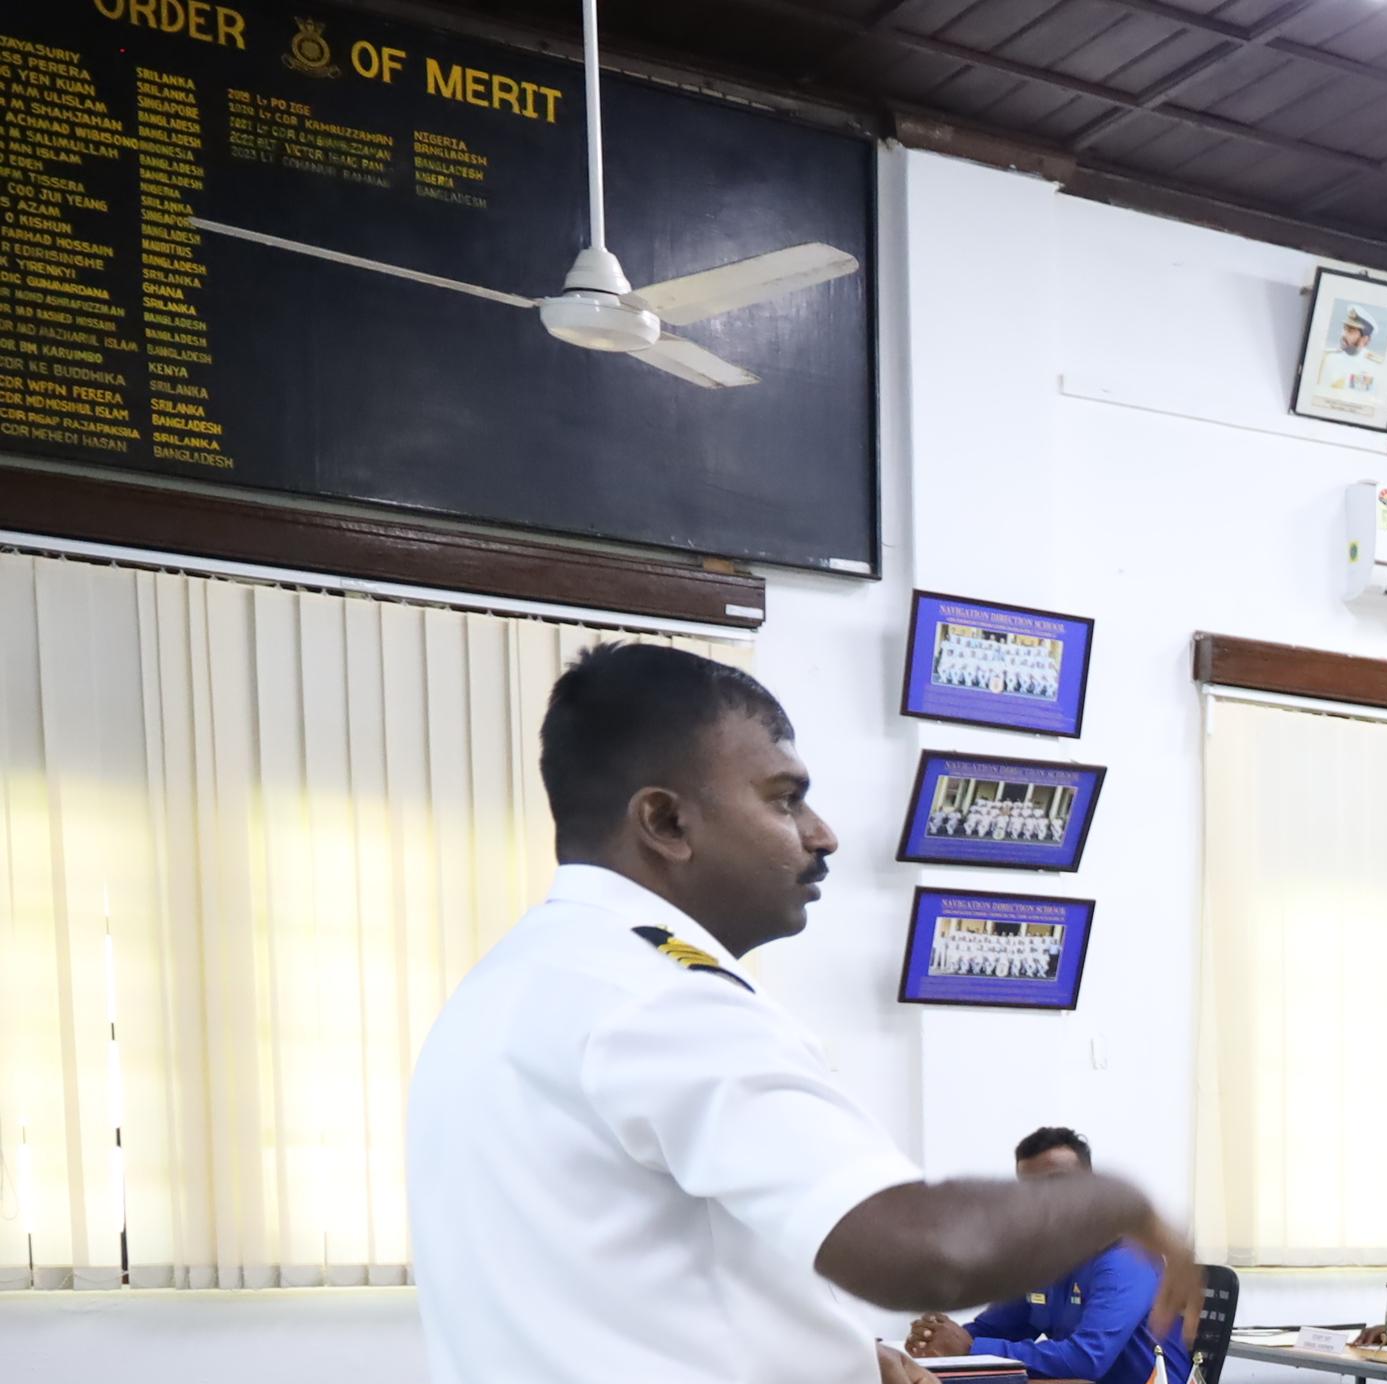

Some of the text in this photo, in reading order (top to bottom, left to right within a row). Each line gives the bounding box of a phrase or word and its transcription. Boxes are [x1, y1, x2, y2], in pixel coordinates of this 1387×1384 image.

[351, 40, 406, 84] OF
[425, 58, 562, 124] MERIT
[414, 130, 467, 151] NIGERIA
